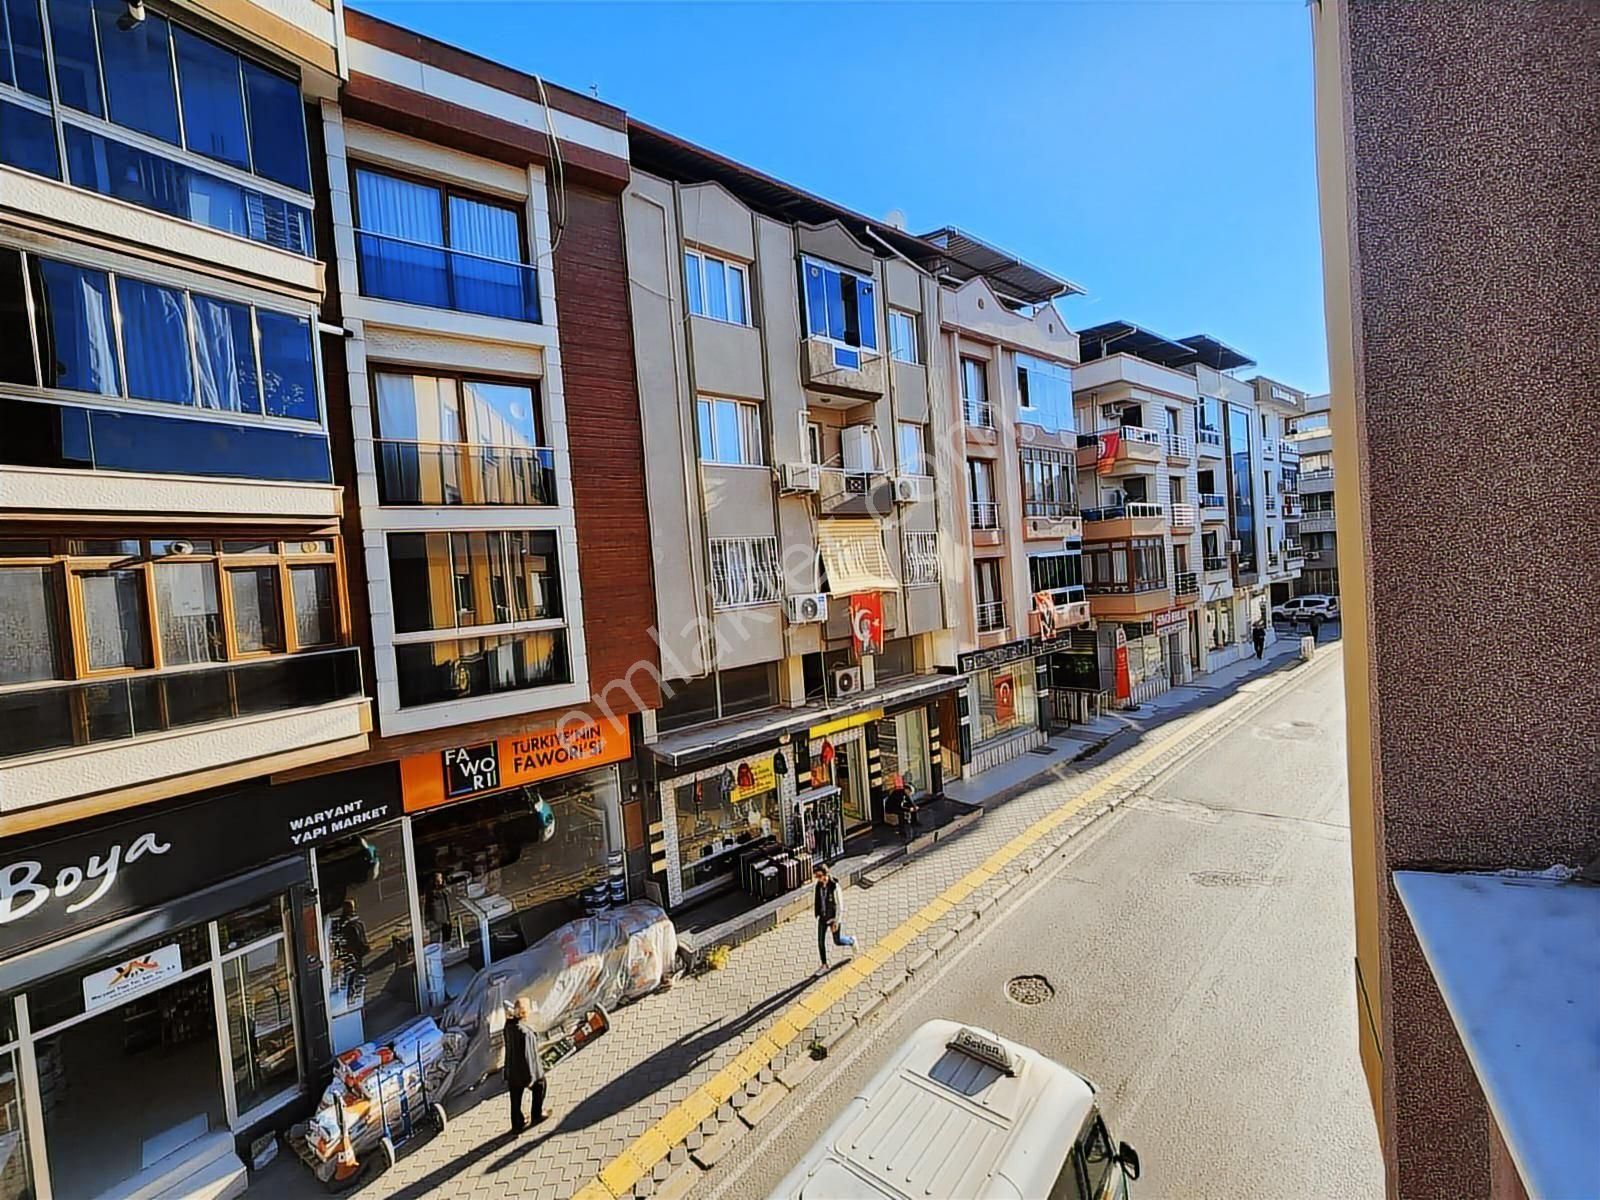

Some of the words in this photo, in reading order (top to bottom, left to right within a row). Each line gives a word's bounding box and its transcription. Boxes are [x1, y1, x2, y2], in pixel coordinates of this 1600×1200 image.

[290, 800, 363, 831] WARYANT
[291, 826, 327, 845] YAPI
[331, 805, 388, 832] MARKET
[0, 833, 172, 924] Boya
